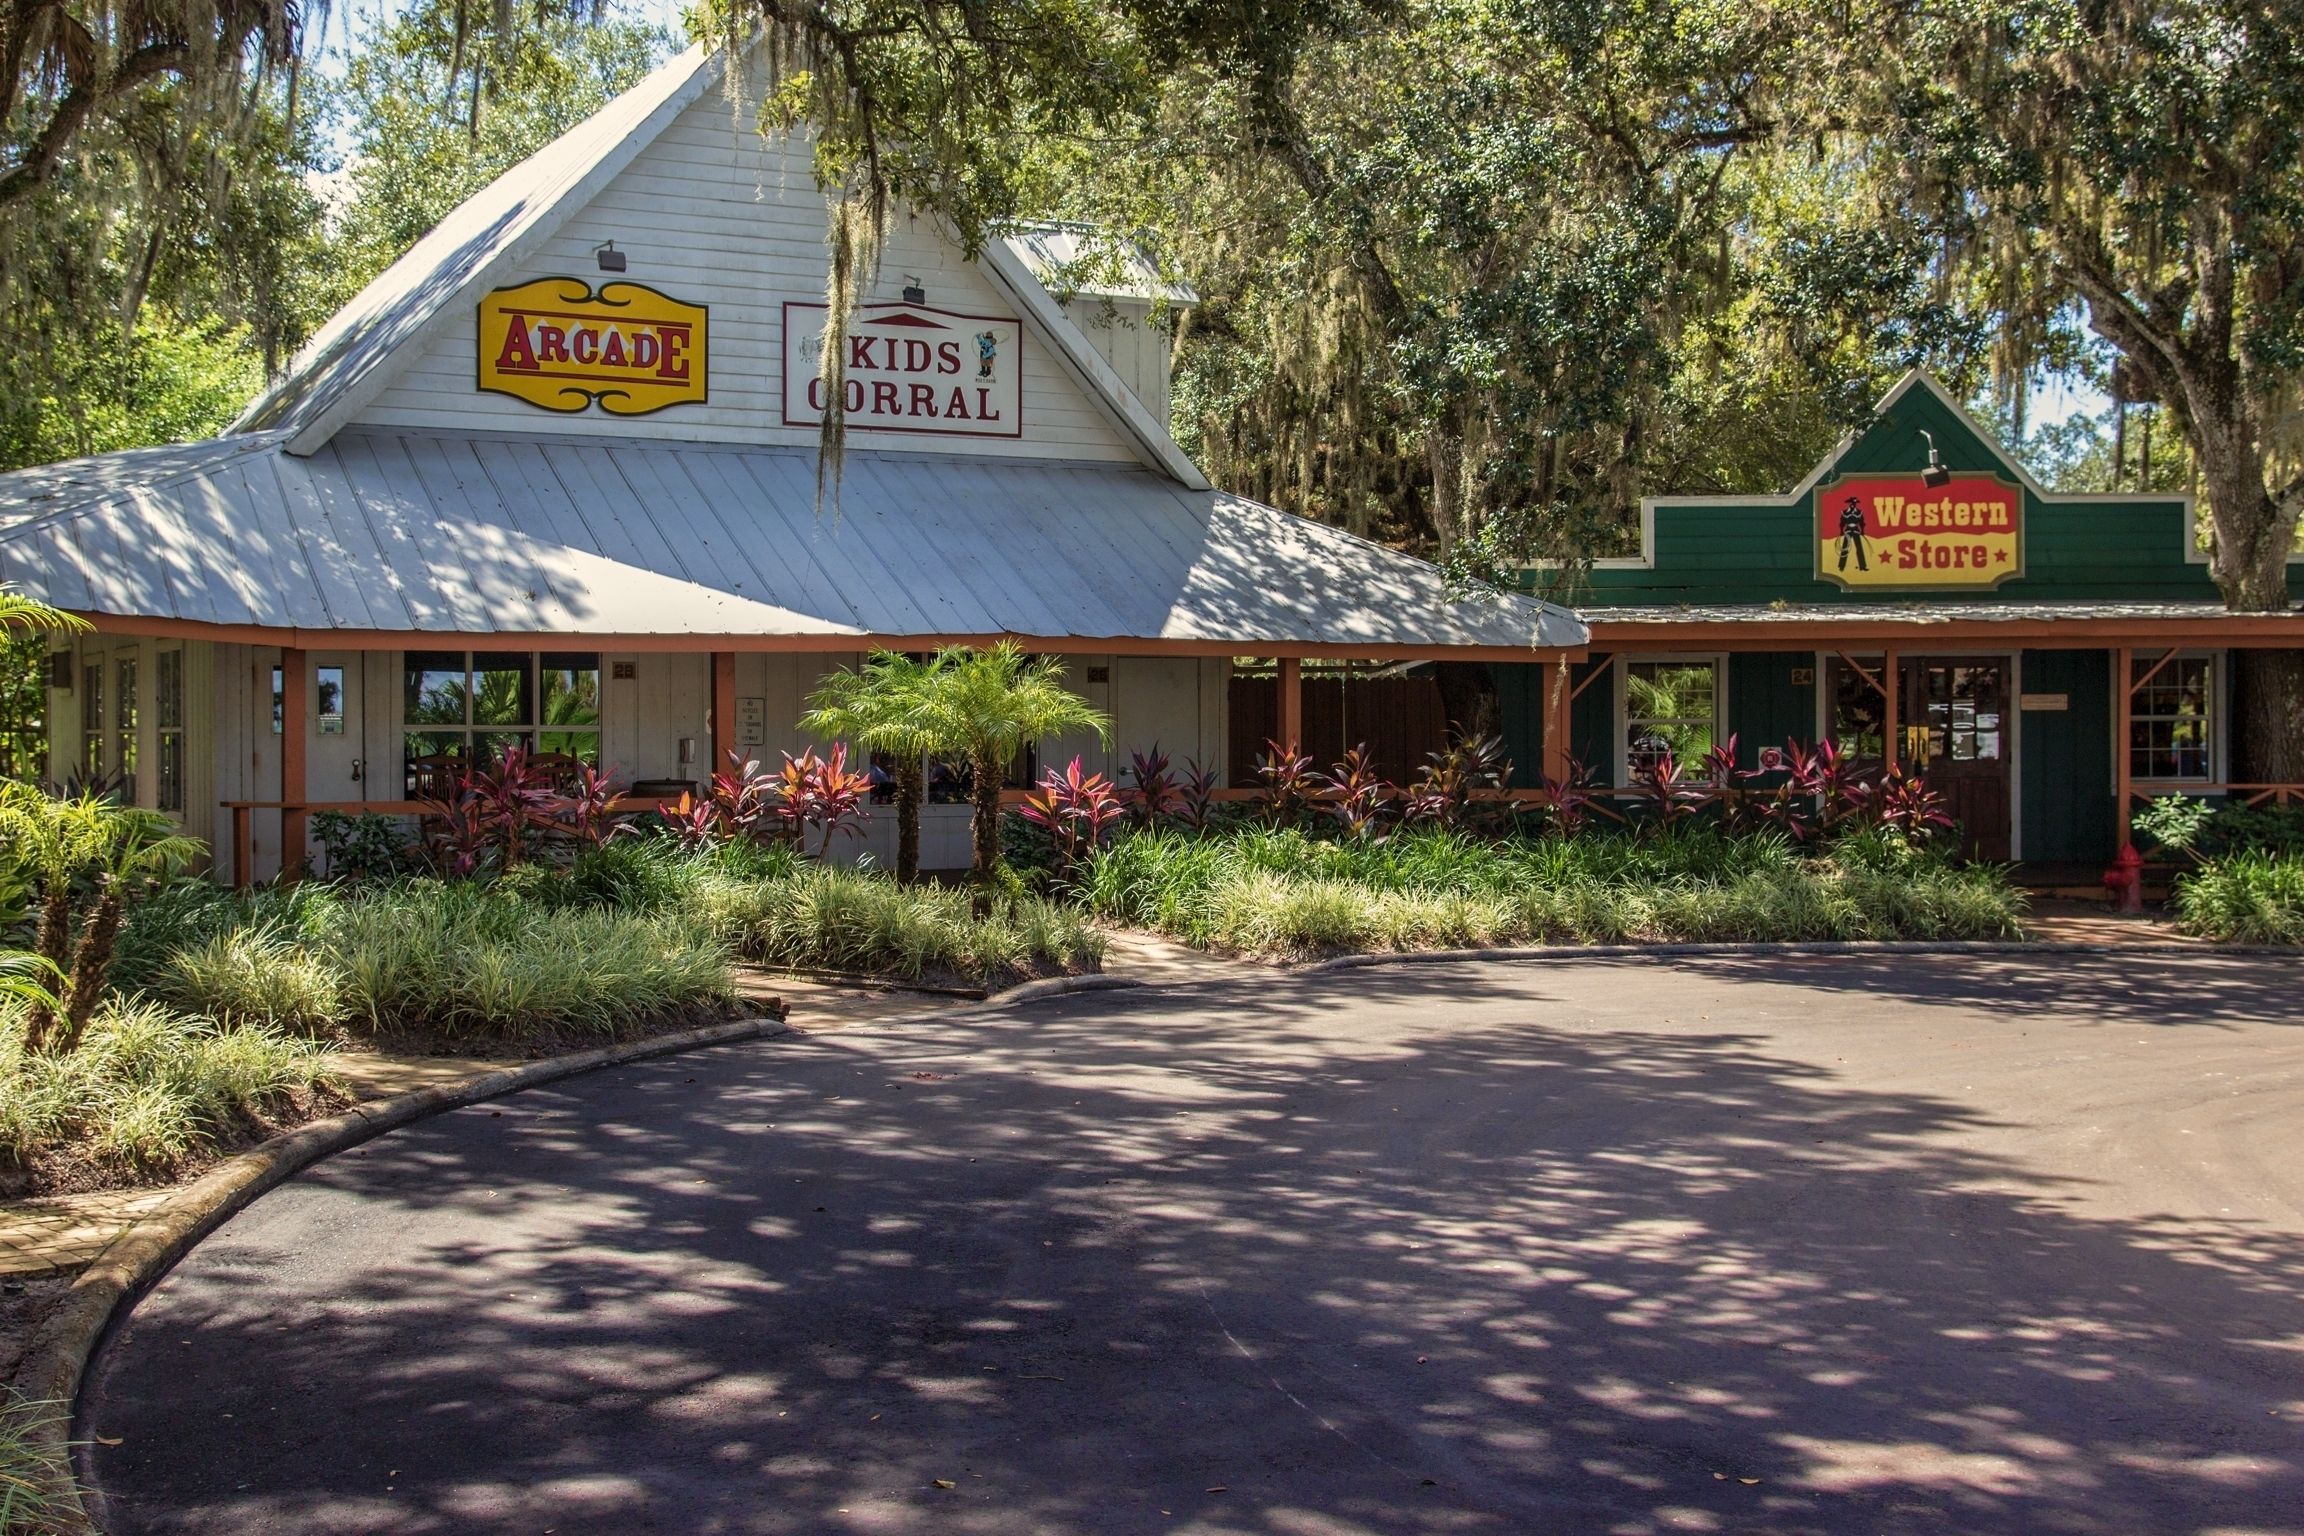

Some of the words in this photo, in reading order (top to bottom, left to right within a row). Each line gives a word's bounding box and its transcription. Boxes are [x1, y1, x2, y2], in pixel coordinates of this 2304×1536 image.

[495, 314, 690, 379] ARCADE
[848, 335, 961, 375] KIDS
[808, 376, 1000, 421] CORRAL
[1873, 497, 2008, 527] Western
[1898, 539, 1988, 569] Store
[1794, 671, 1811, 682] 24
